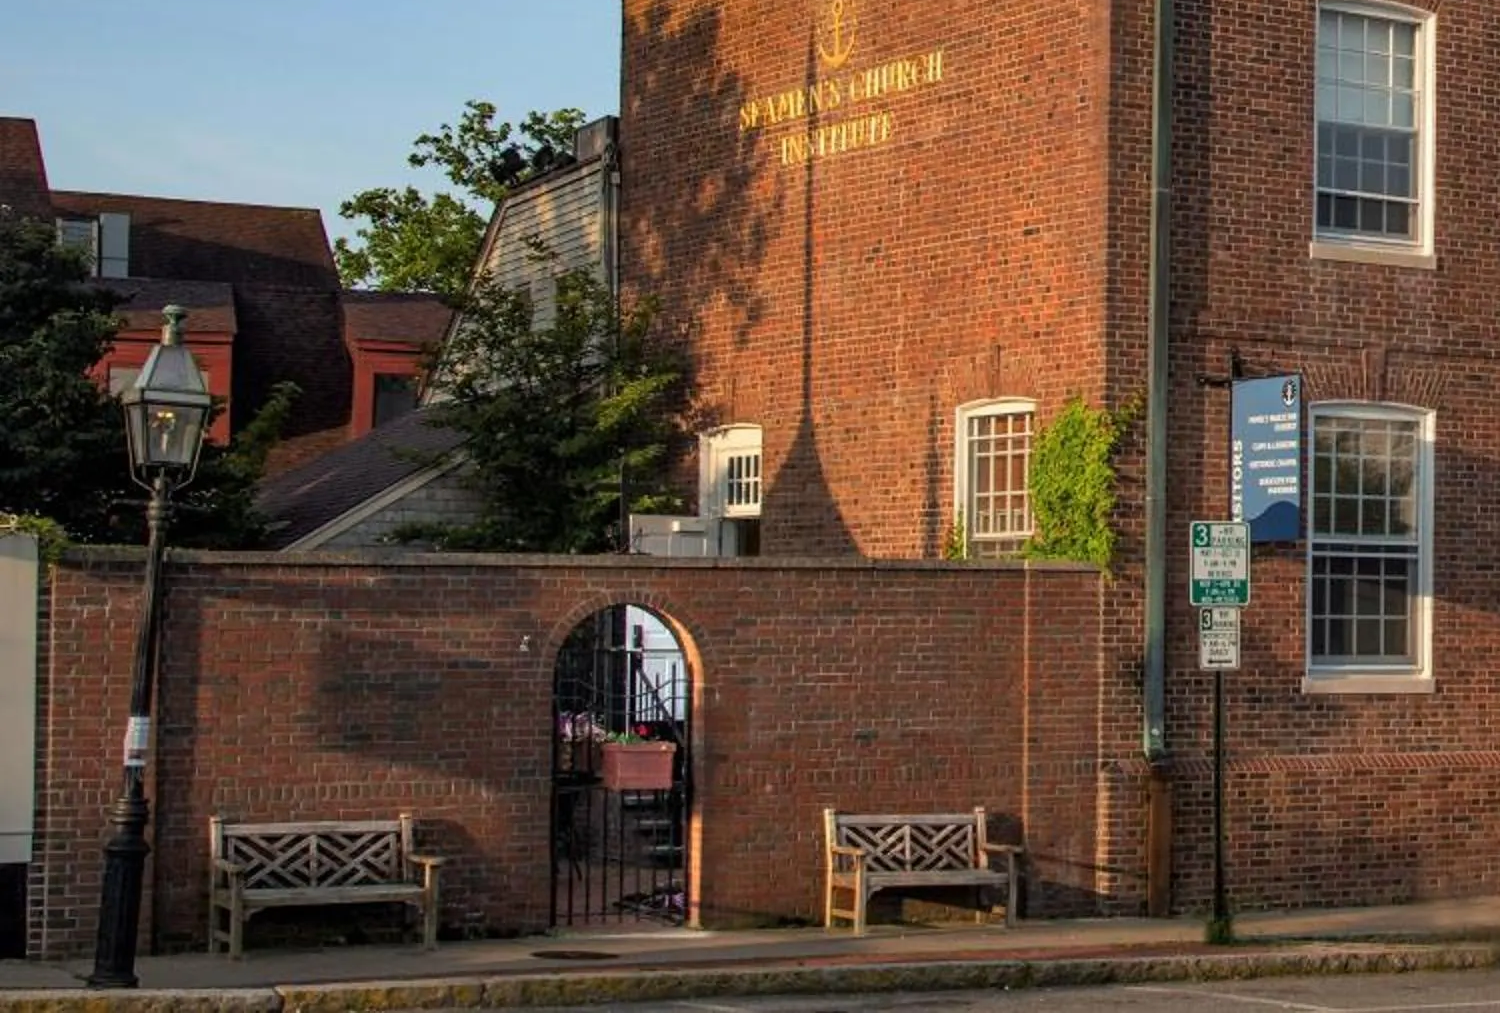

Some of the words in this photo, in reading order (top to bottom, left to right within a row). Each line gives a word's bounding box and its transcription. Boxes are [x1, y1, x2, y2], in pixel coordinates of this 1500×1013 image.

[850, 49, 943, 100] CHURCH
[781, 111, 894, 165] INSTITUTE
[1232, 439, 1243, 522] ISITORS
[1195, 524, 1210, 546] 3
[1202, 611, 1211, 629] 3
